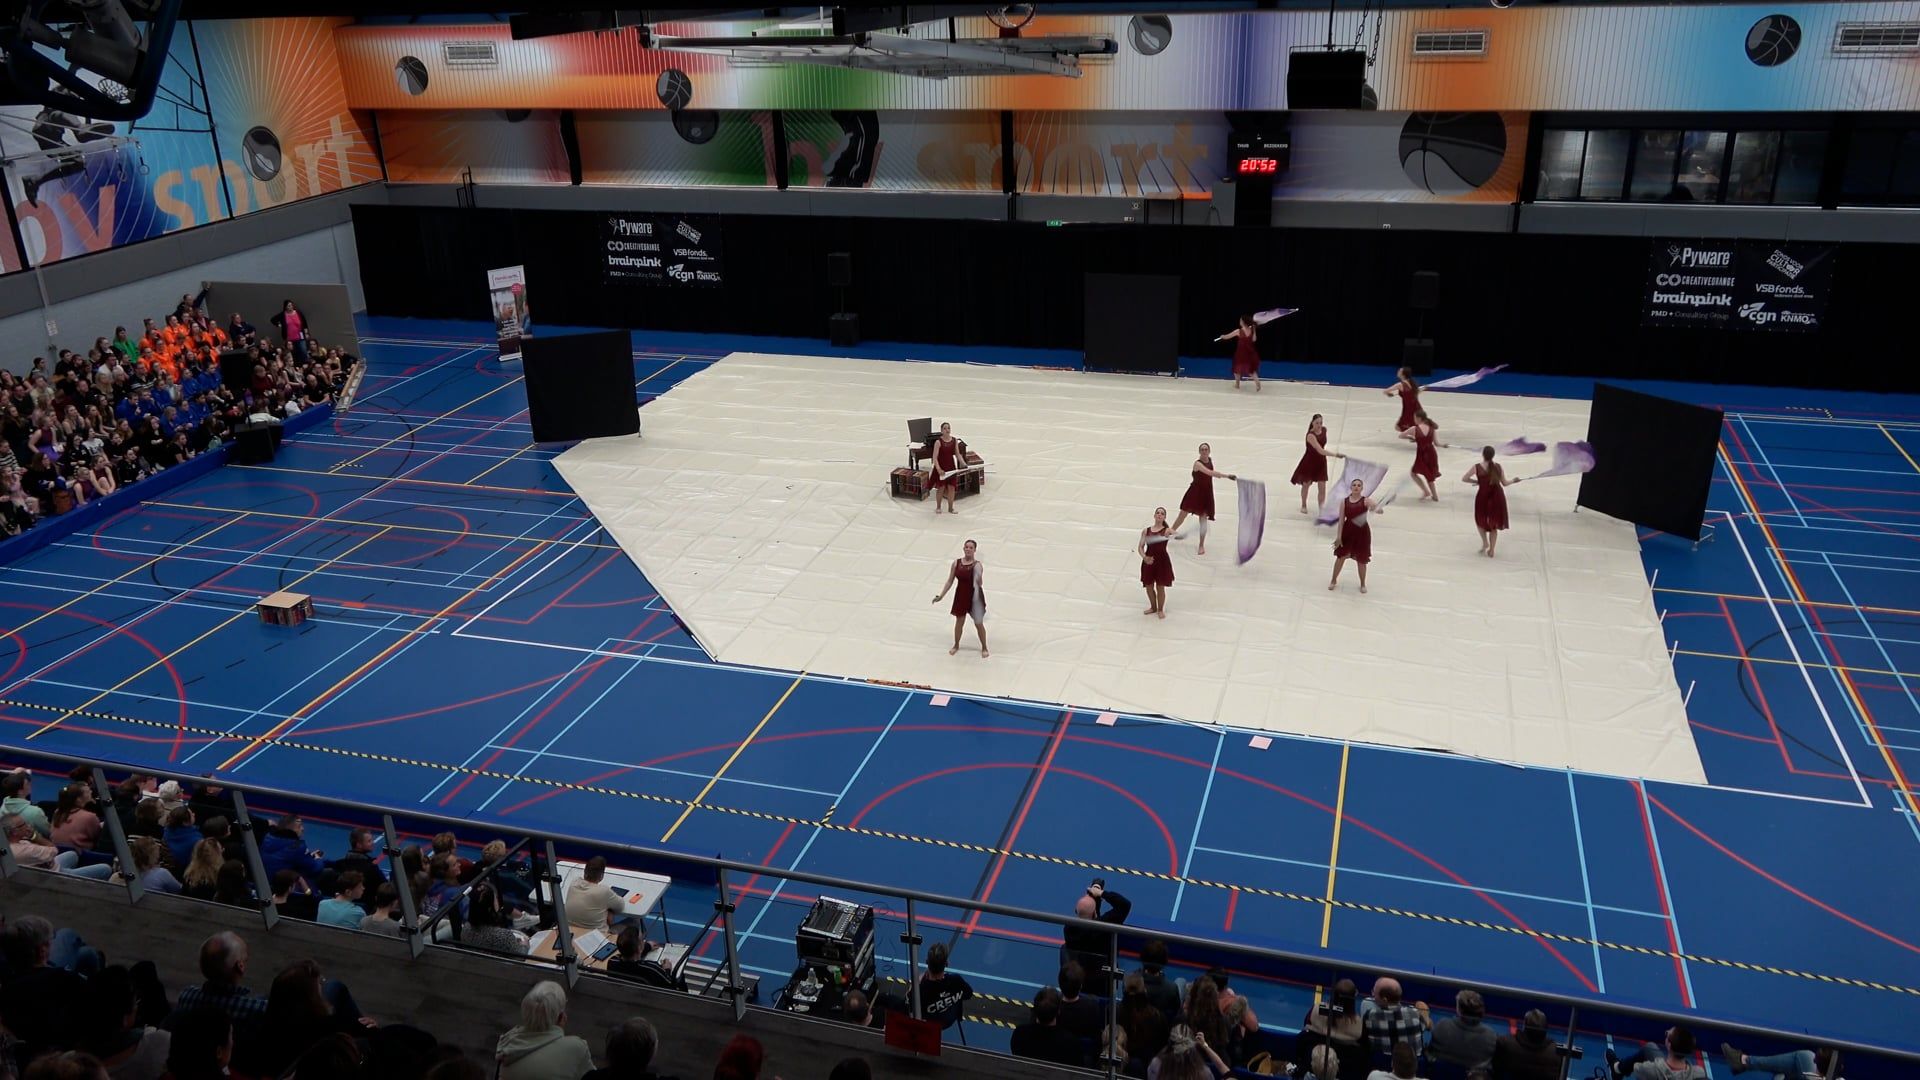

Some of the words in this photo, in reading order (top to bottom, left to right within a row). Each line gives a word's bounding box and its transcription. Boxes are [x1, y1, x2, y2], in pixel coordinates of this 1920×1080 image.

[1240, 159, 1277, 170] 20:52
[619, 219, 652, 235] Pyware
[608, 255, 662, 268] brainpink
[1681, 247, 1730, 267] Pyware
[675, 271, 695, 282] cgn
[1653, 291, 1732, 307] brainpink
[1748, 311, 1777, 325] cgn
[927, 990, 963, 1013] CREW
